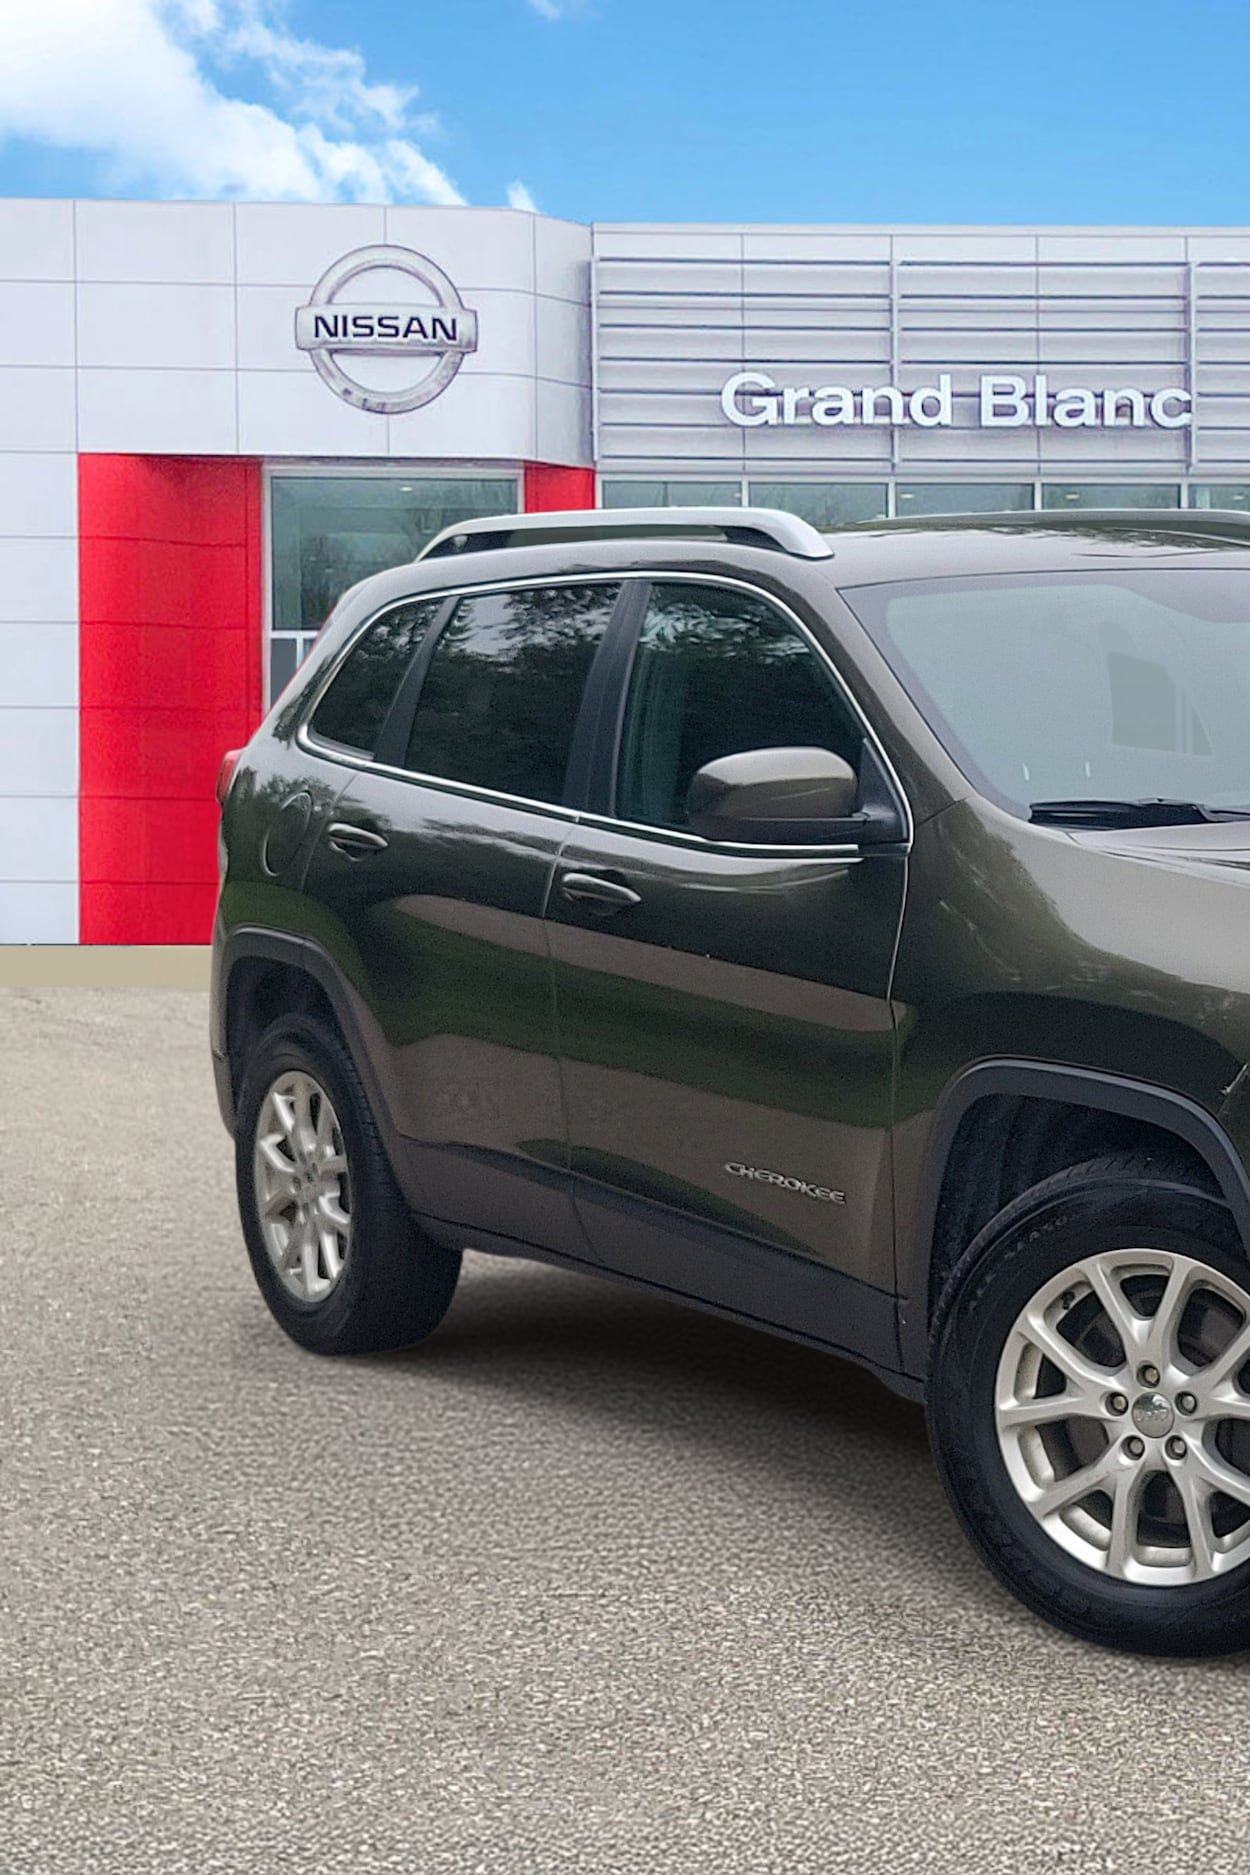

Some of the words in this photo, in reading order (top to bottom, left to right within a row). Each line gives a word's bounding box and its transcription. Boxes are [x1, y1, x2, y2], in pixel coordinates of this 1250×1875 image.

[314, 314, 457, 341] NISSAN
[720, 372, 951, 427] Grand
[980, 374, 1193, 428] Blanc
[724, 1161, 847, 1205] CHEROKEE
